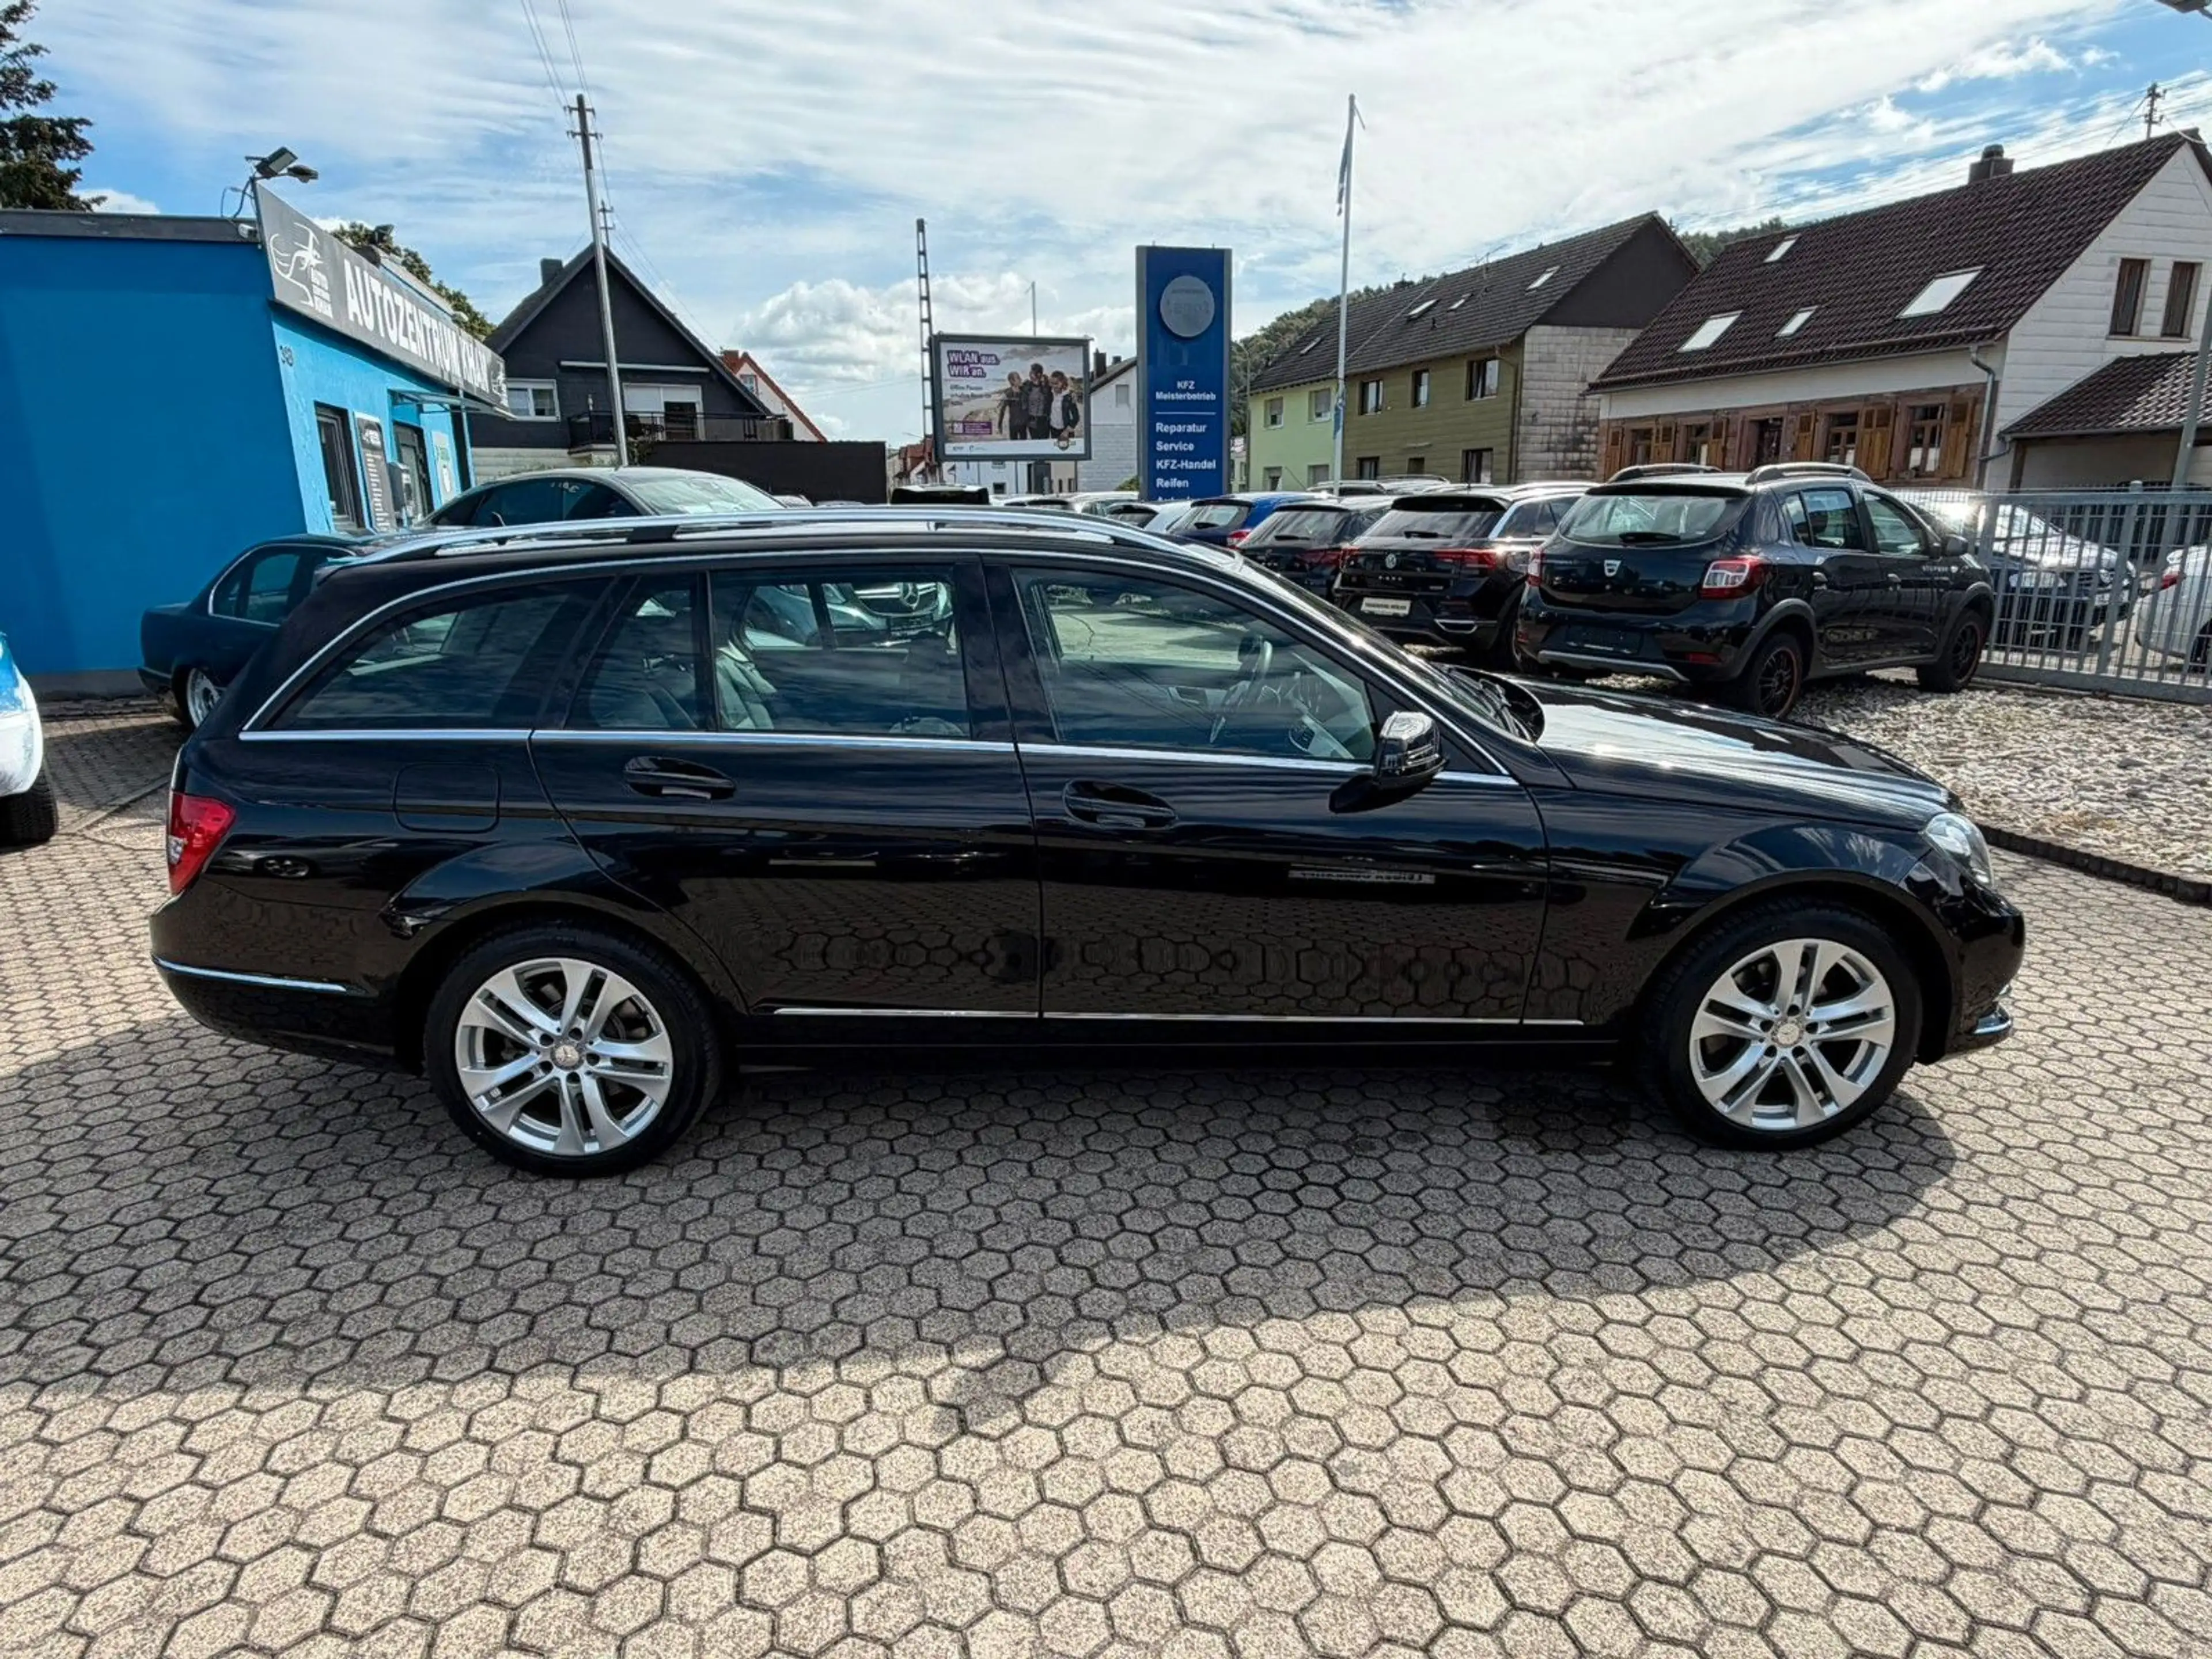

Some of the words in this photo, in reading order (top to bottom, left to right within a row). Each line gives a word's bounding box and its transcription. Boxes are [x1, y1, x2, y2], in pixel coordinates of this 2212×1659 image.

[949, 352, 978, 363] WLAN
[949, 365, 969, 376] WIR
[1177, 381, 1195, 389] KFZ
[1156, 392, 1216, 400] Meisterbetrieb
[1156, 422, 1207, 435] Reparatur
[1156, 441, 1195, 451] Service
[1156, 460, 1216, 469] KFZ-Handel
[1156, 478, 1189, 488] Reifen
